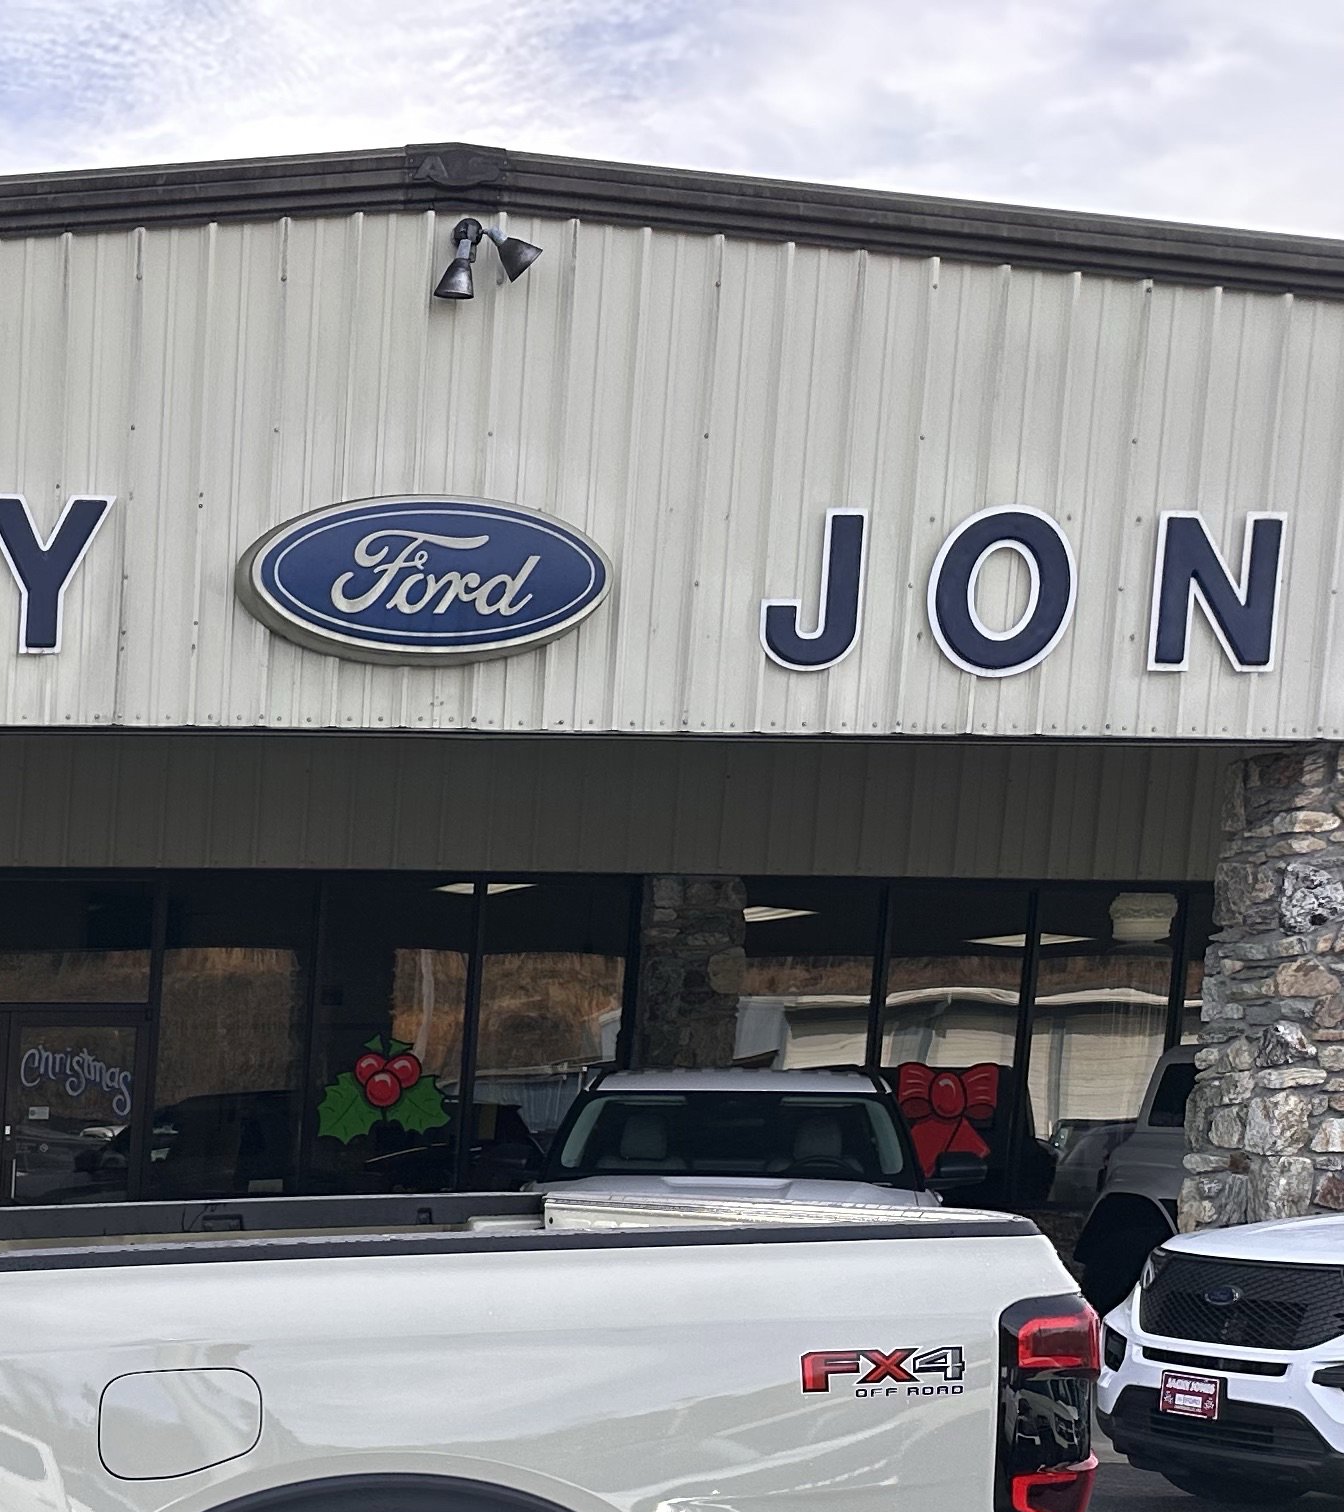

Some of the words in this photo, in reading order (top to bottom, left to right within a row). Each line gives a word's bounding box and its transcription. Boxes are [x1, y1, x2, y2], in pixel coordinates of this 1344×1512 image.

[331, 529, 541, 616] Ford
[759, 503, 1289, 678] JON
[20, 1045, 132, 1116] Christmas
[799, 1346, 966, 1394] FX4
[854, 1387, 898, 1398] OFF
[906, 1384, 965, 1397] ROAD
